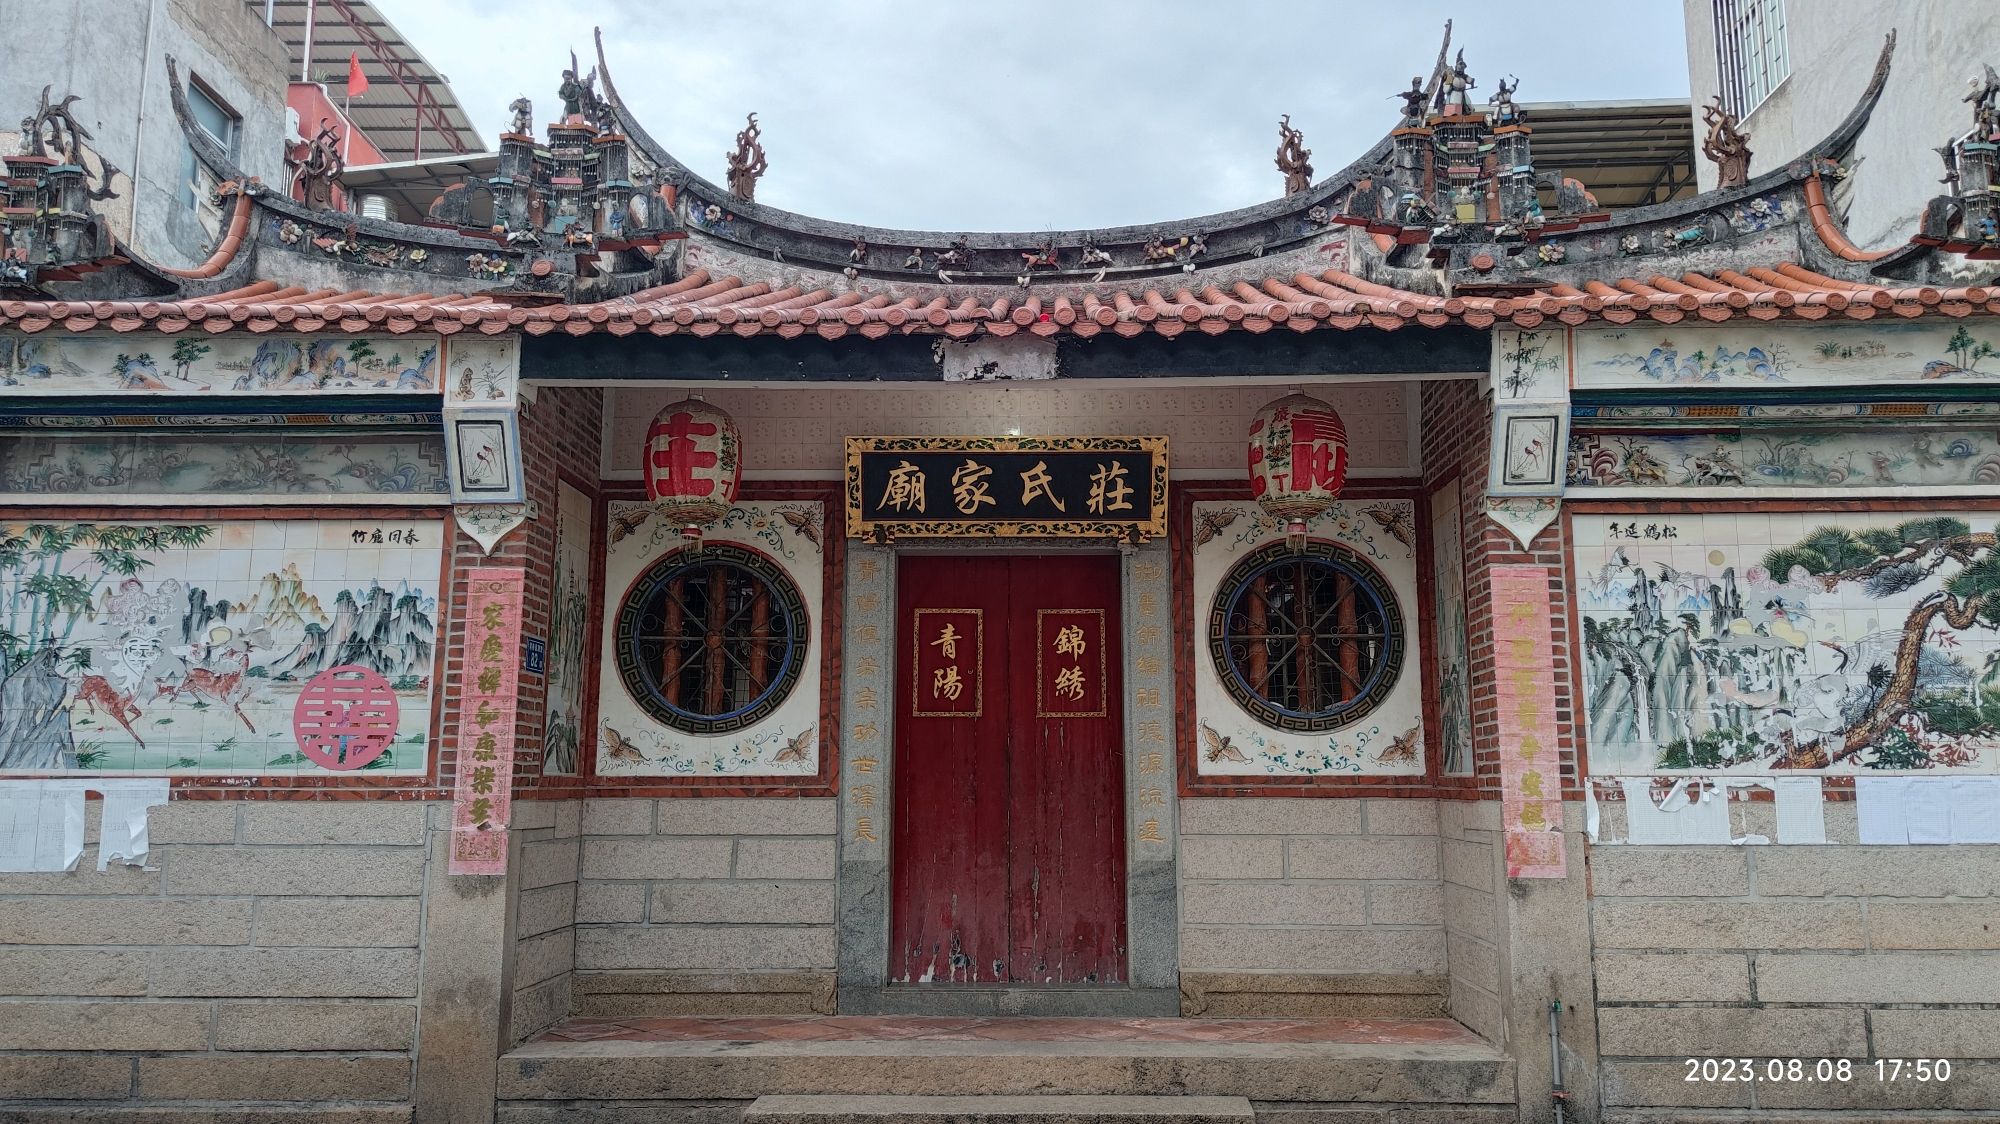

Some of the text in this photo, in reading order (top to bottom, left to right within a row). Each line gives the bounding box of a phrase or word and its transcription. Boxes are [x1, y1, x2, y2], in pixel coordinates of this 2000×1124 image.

[876, 458, 1135, 516] 莊氏家廟
[1609, 521, 1678, 541] 松鶴延年
[930, 622, 964, 702] 青陽
